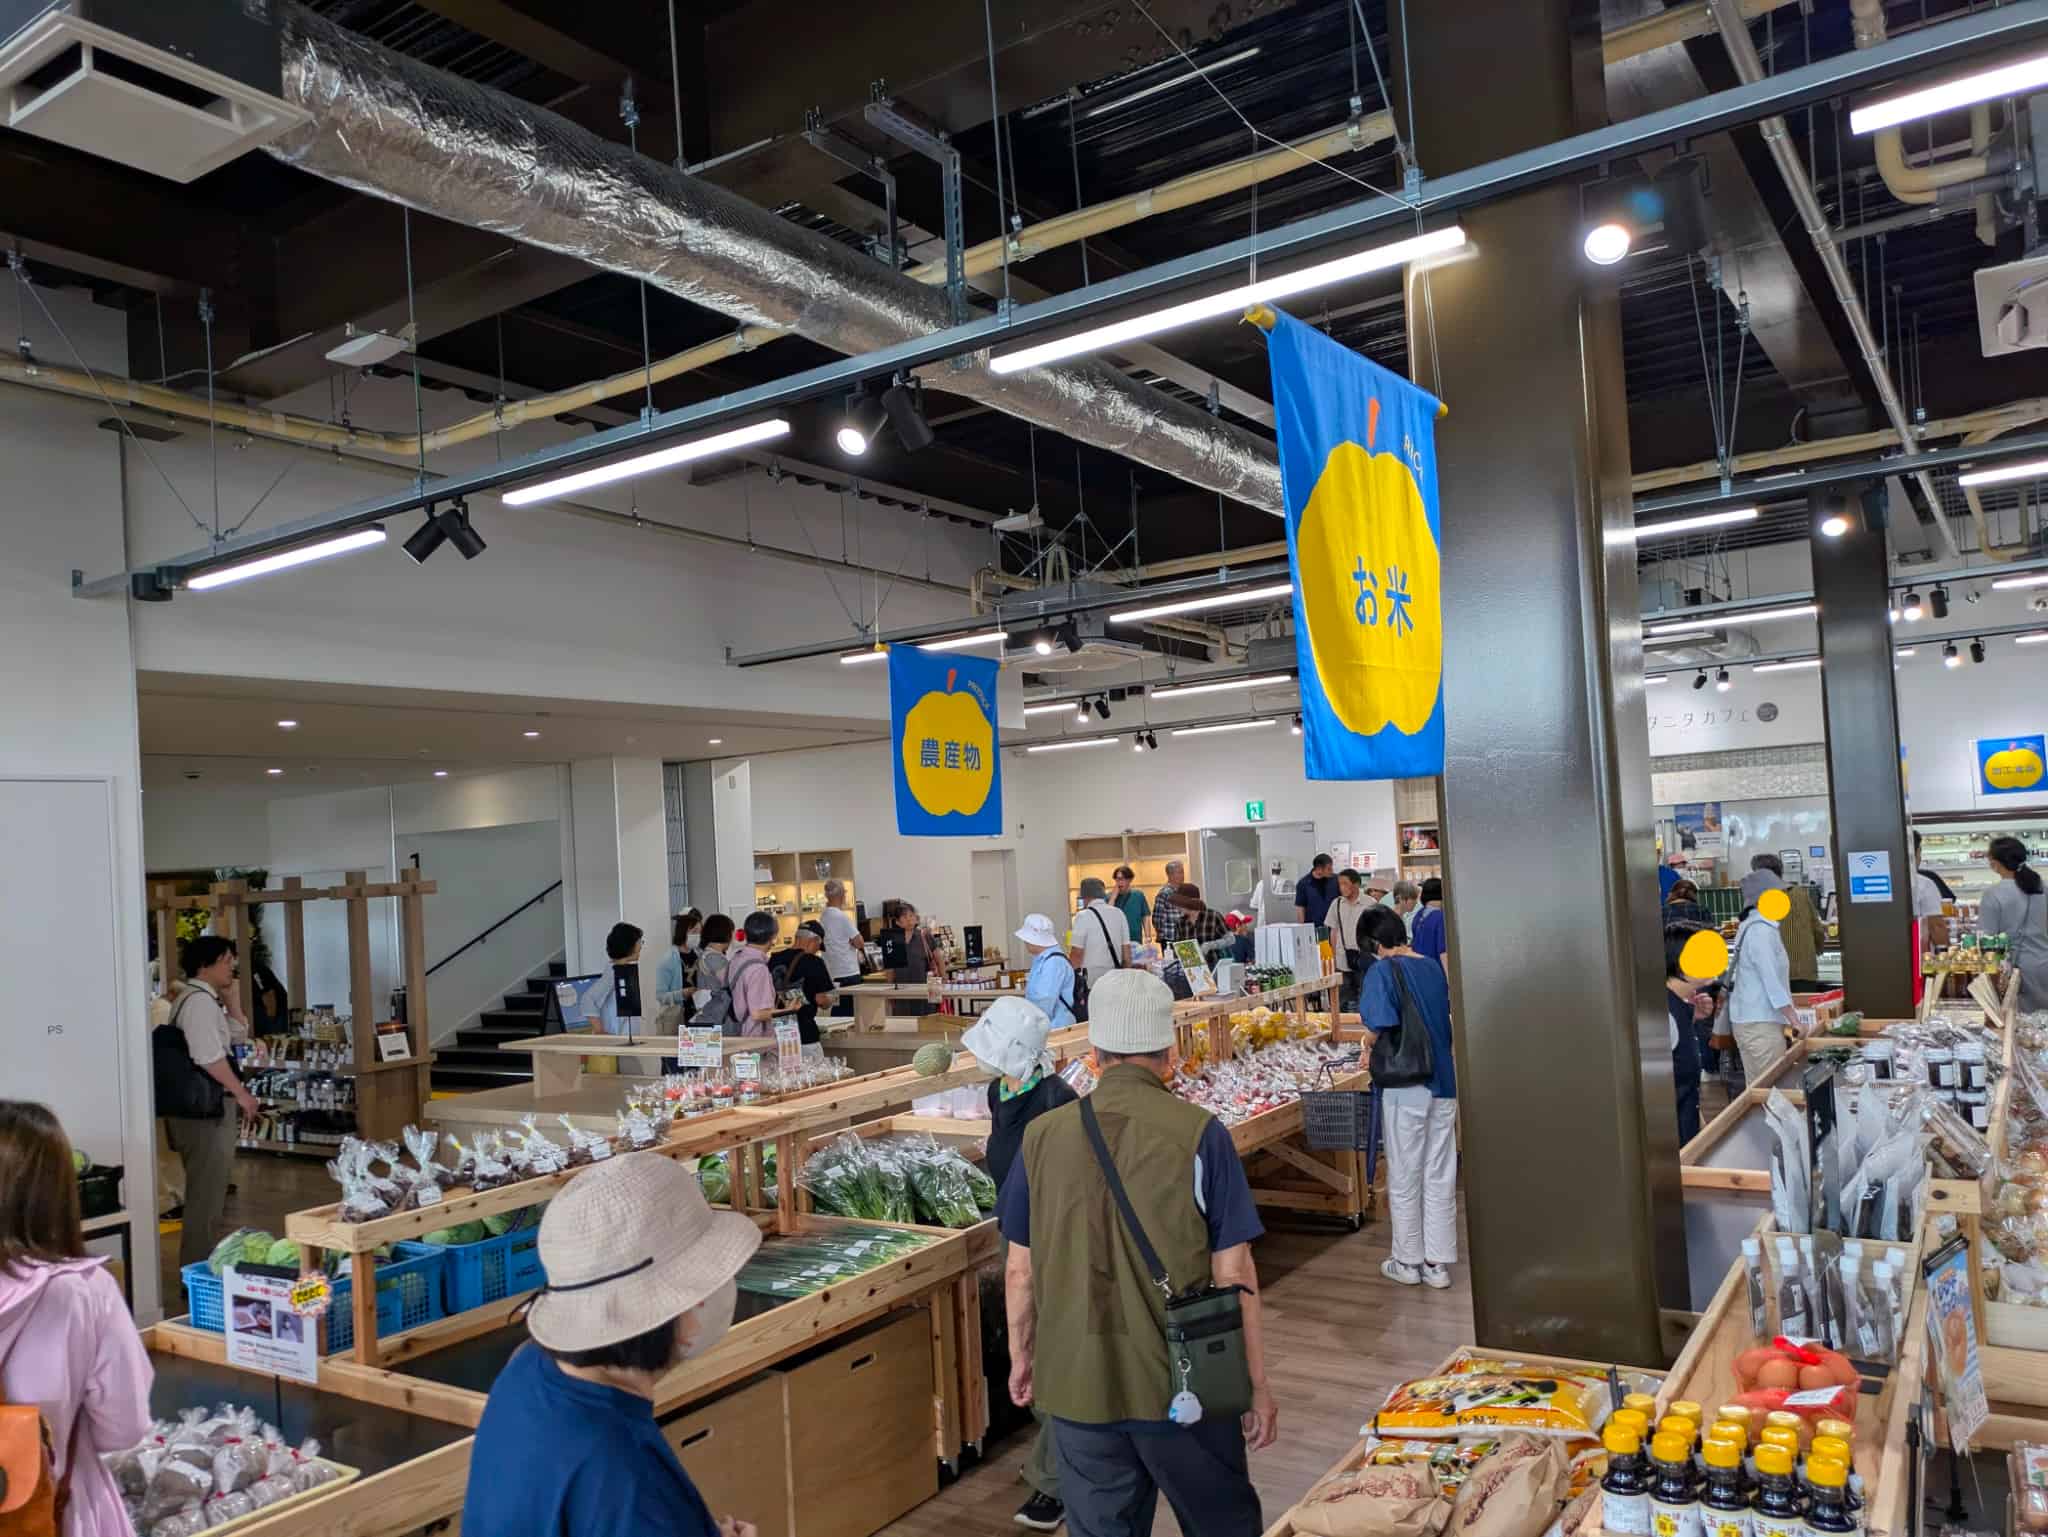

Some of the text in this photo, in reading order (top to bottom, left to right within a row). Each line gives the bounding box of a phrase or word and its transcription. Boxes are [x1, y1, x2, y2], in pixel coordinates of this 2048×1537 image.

[1353, 556, 1413, 636] お米
[921, 738, 981, 770] 農産物
[48, 1024, 64, 1036] PS
